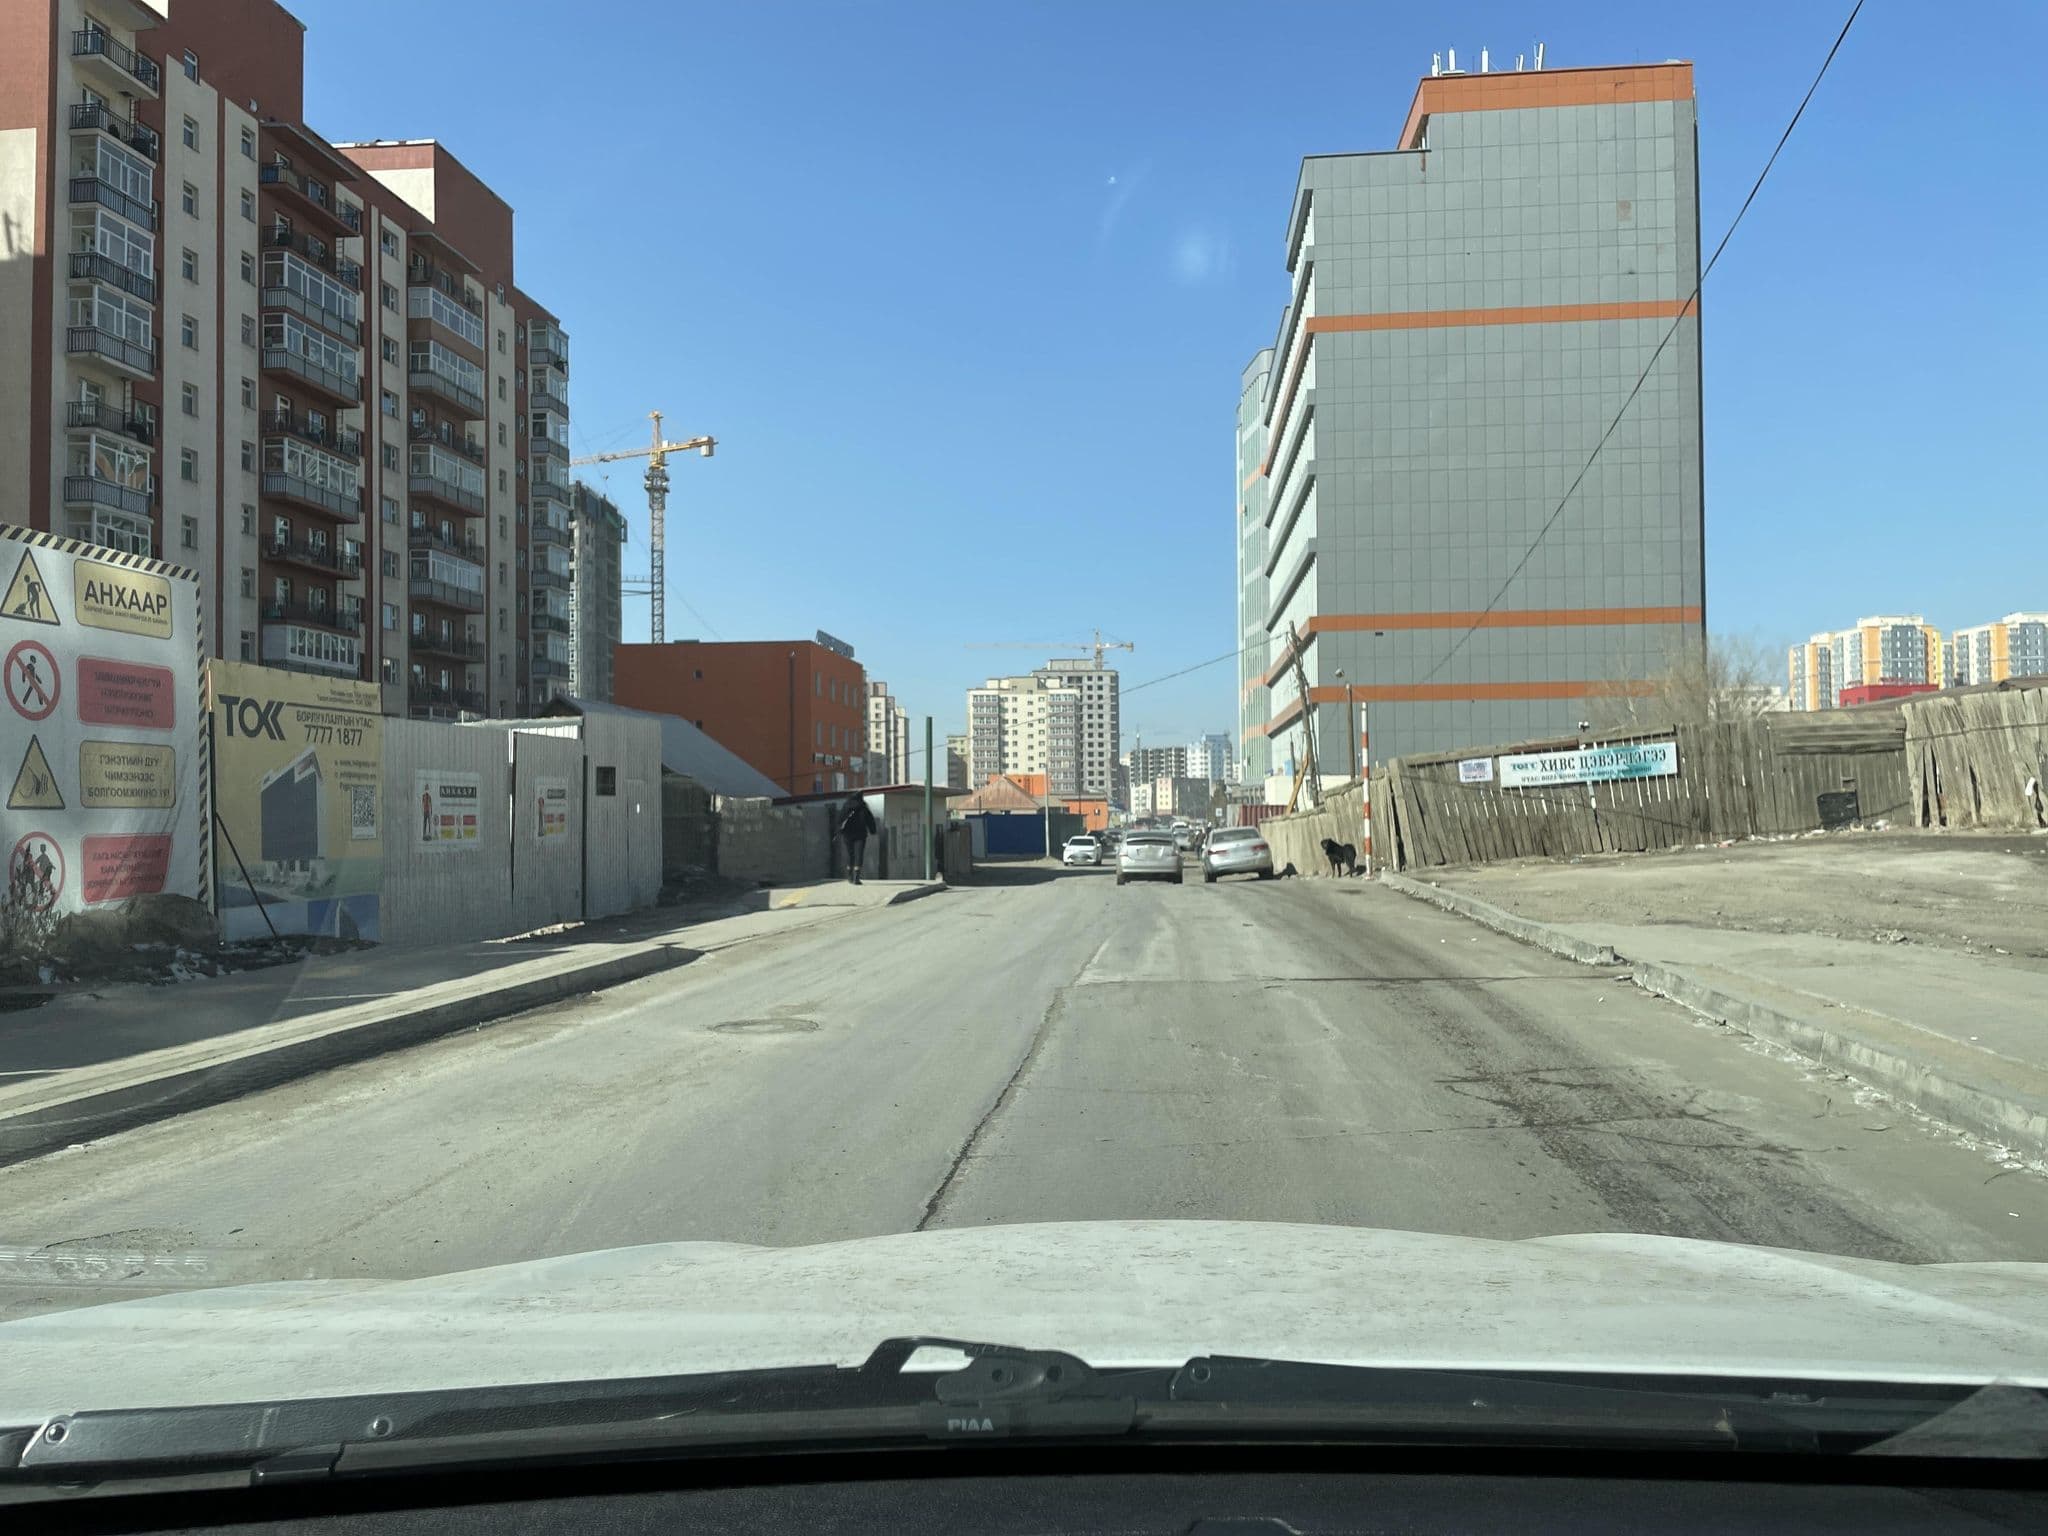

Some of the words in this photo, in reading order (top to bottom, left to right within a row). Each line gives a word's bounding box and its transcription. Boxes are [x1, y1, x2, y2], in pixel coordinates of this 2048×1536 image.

[84, 580, 167, 615] АНХААР
[304, 724, 333, 744] 7777
[337, 728, 362, 746] 1877
[1540, 758, 1575, 772] ХИВС
[1580, 749, 1666, 771] ЦЭВЭРЛЭГЭЭ
[948, 1418, 993, 1432] PIAA
